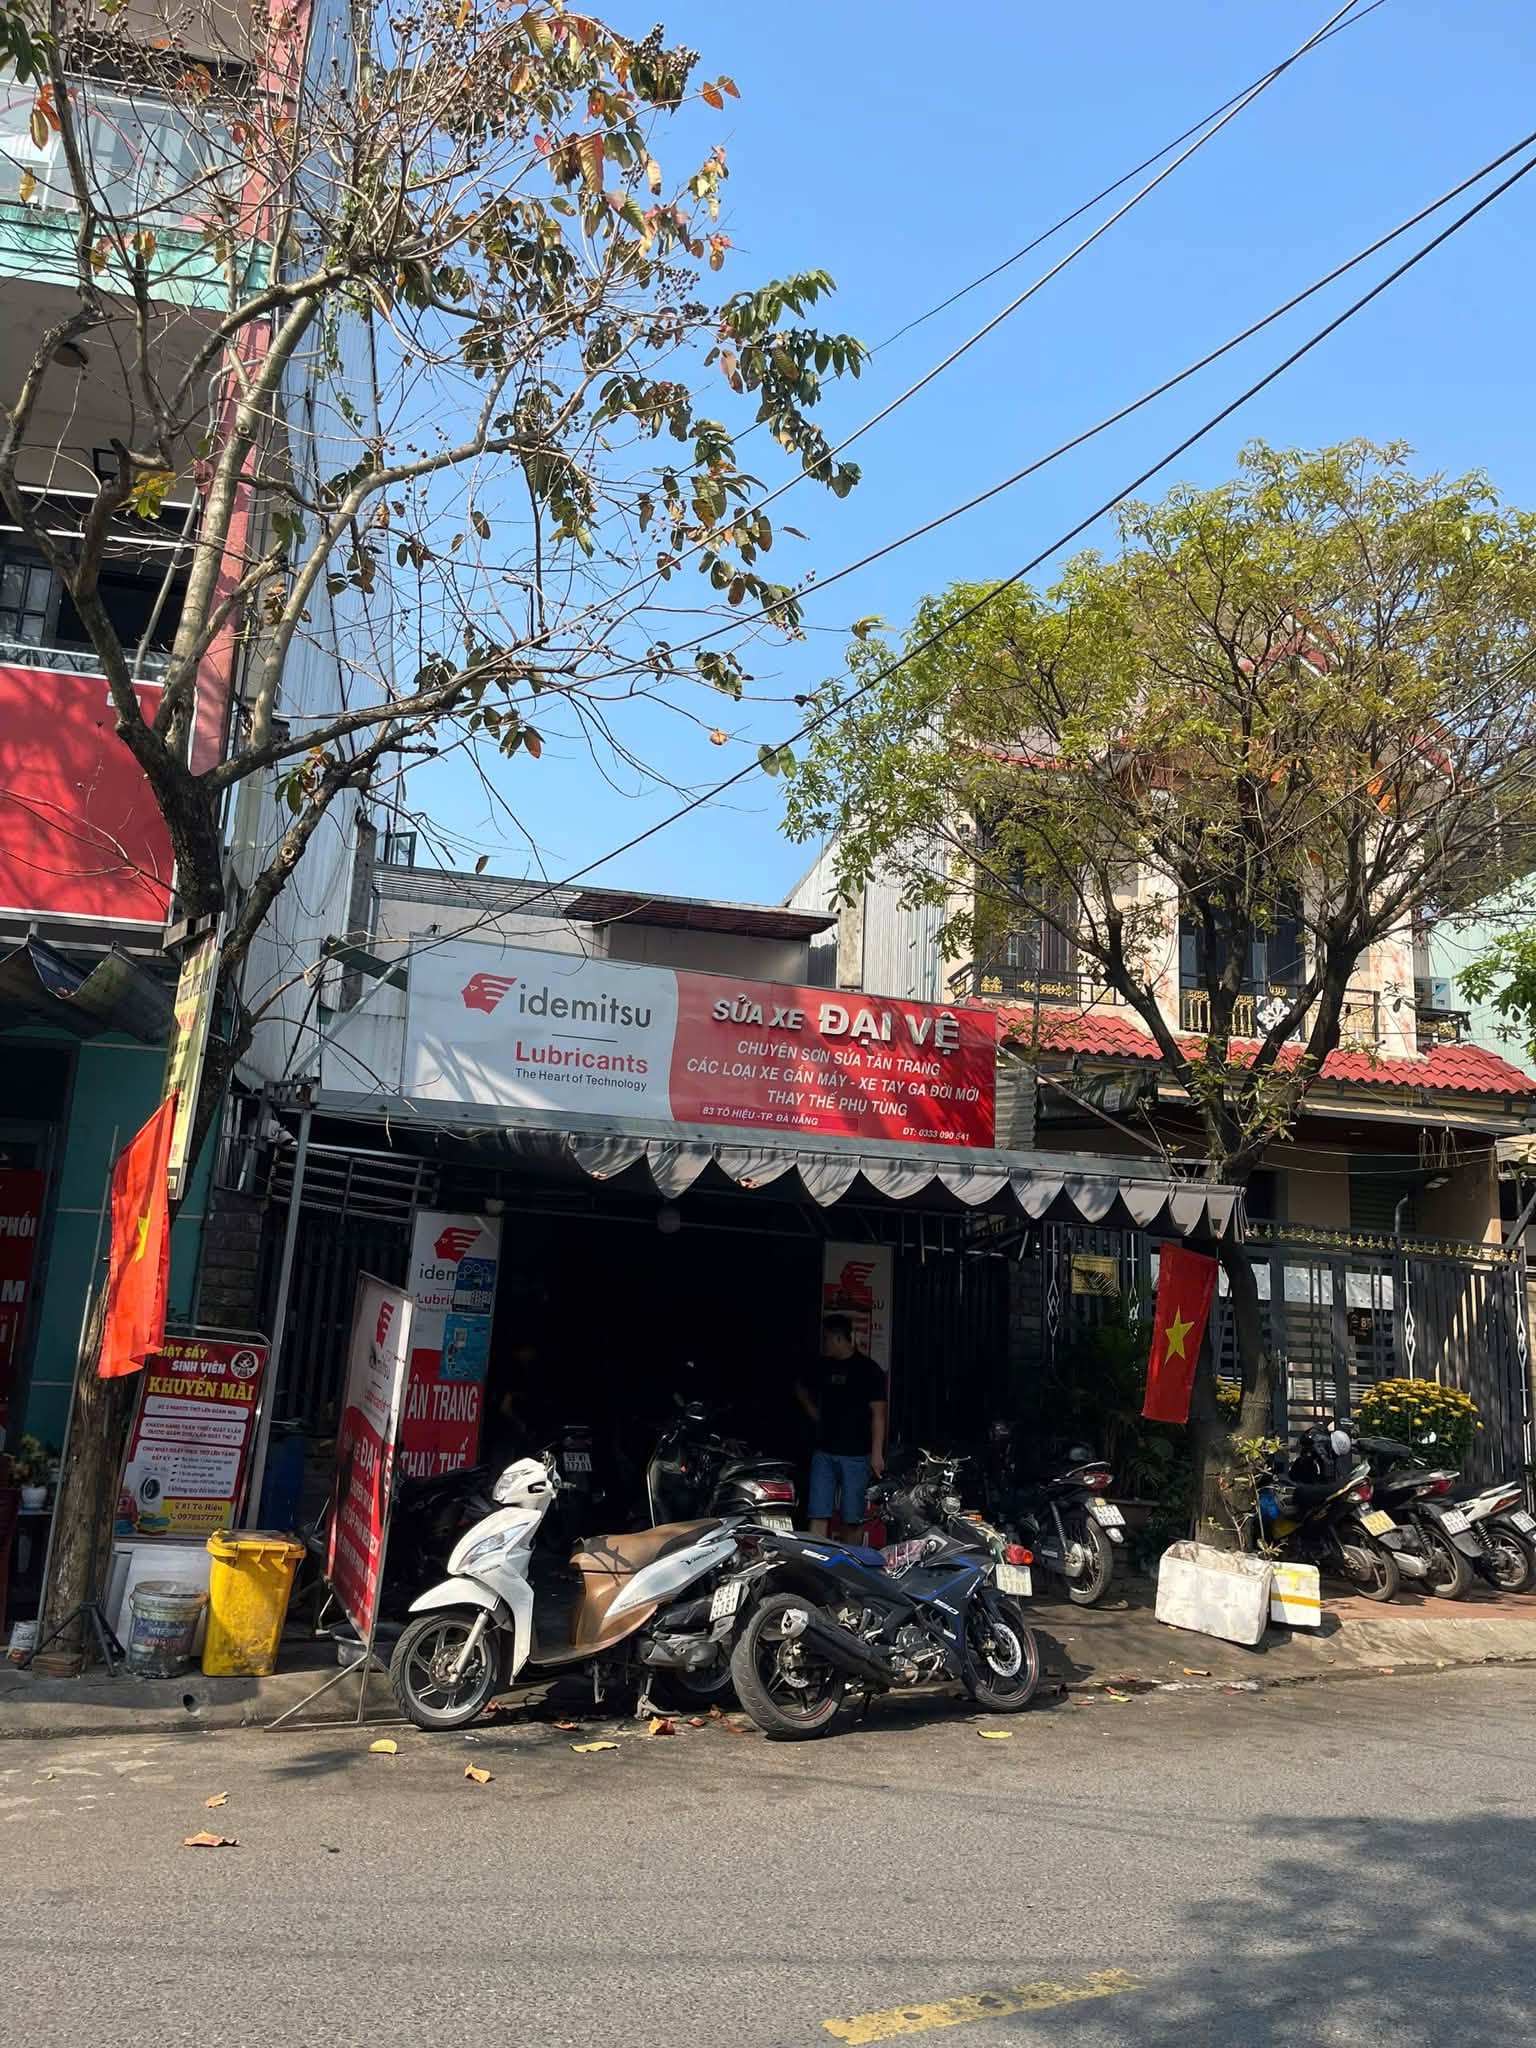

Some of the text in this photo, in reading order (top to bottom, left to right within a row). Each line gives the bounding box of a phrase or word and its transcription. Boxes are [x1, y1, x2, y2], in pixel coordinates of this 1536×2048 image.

[519, 983, 651, 1028] idemitsu
[712, 993, 960, 1055] SỬA XE ĐẠI VỆ
[515, 1040, 649, 1075] Lubricants
[737, 1040, 941, 1076] CHUYÊN SƠN SỬA TÂN TRANG
[515, 1067, 648, 1092] The Heart of Technology
[687, 1055, 719, 1075] CÁC
[722, 1062, 757, 1081] LOẠI
[759, 1066, 780, 1080] XE
[817, 1070, 848, 1088] MÁY
[858, 1076, 877, 1091] XE
[881, 1079, 905, 1094] TAY
[907, 1082, 926, 1096] GA
[767, 1089, 908, 1117] THAY THẾ PHỤ TÙNG
[918, 1128, 938, 1138] 0333
[939, 1130, 955, 1140] 090
[171, 1360, 227, 1375] SINH VIÊN
[147, 1374, 219, 1398] KHUYẾN
[432, 1384, 479, 1423] TRANG
